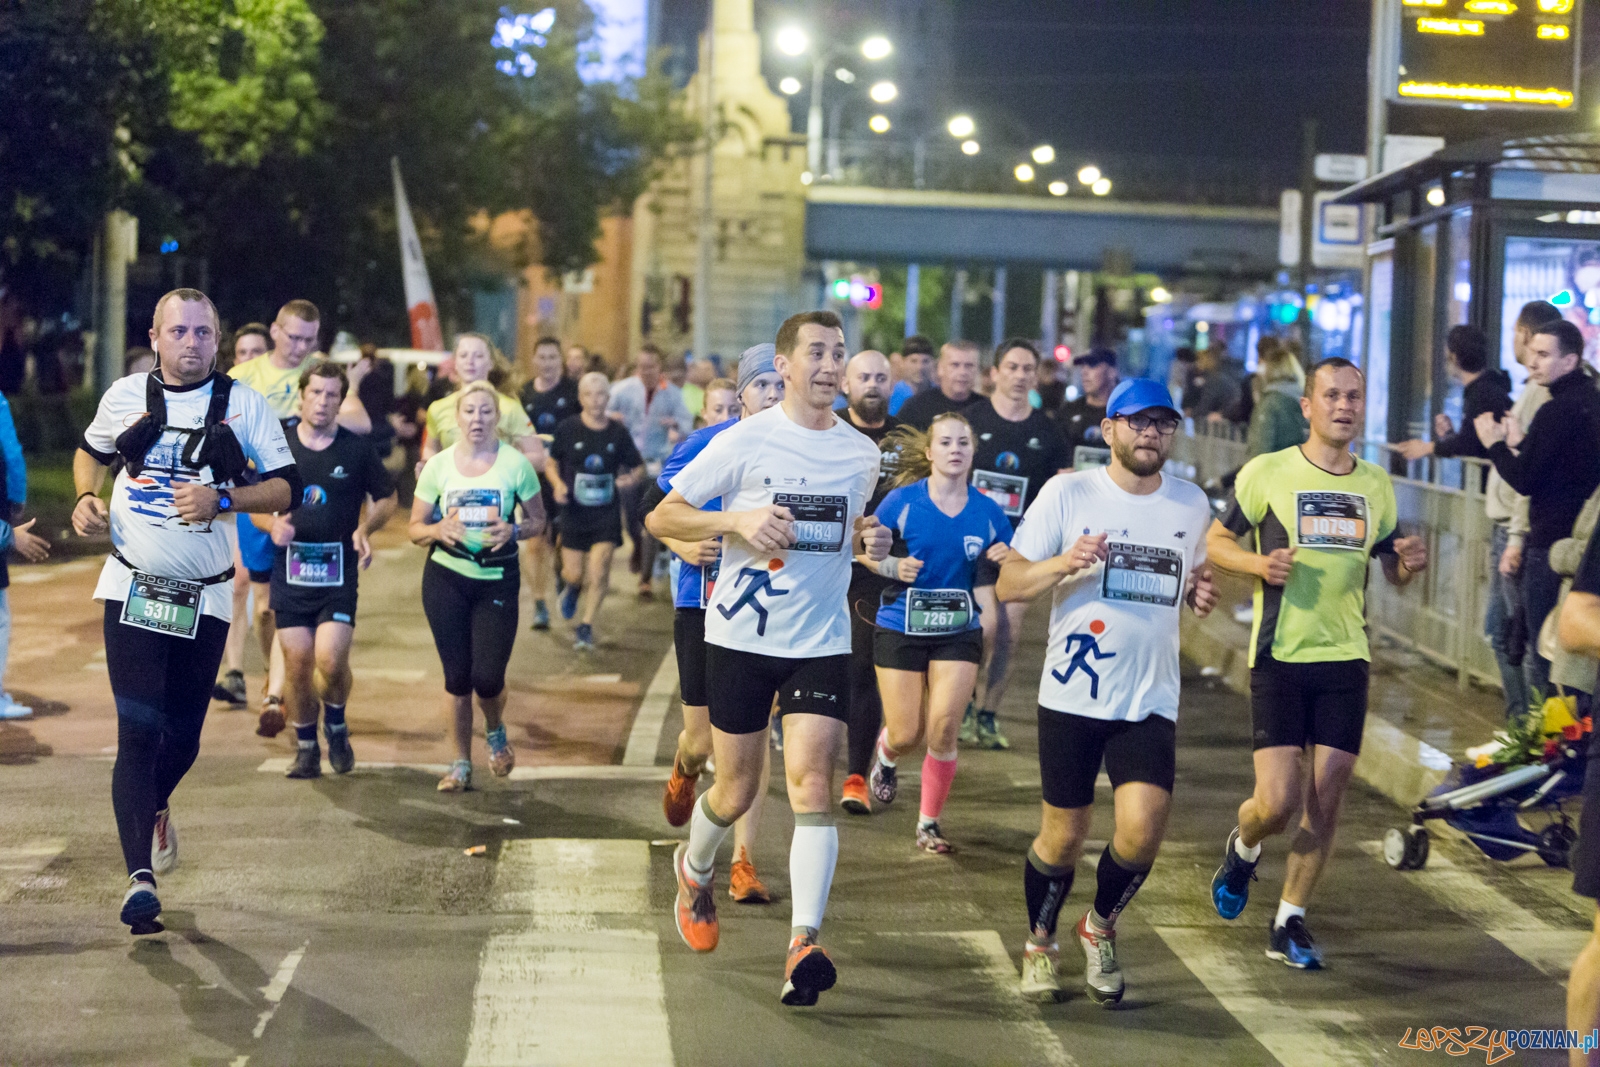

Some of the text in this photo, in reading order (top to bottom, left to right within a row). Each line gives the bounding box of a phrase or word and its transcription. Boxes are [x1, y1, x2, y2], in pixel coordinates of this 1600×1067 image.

[1312, 517, 1357, 537] 10798
[1121, 571, 1165, 594] 11071
[143, 600, 178, 622] 5311
[923, 611, 955, 626] 7267
